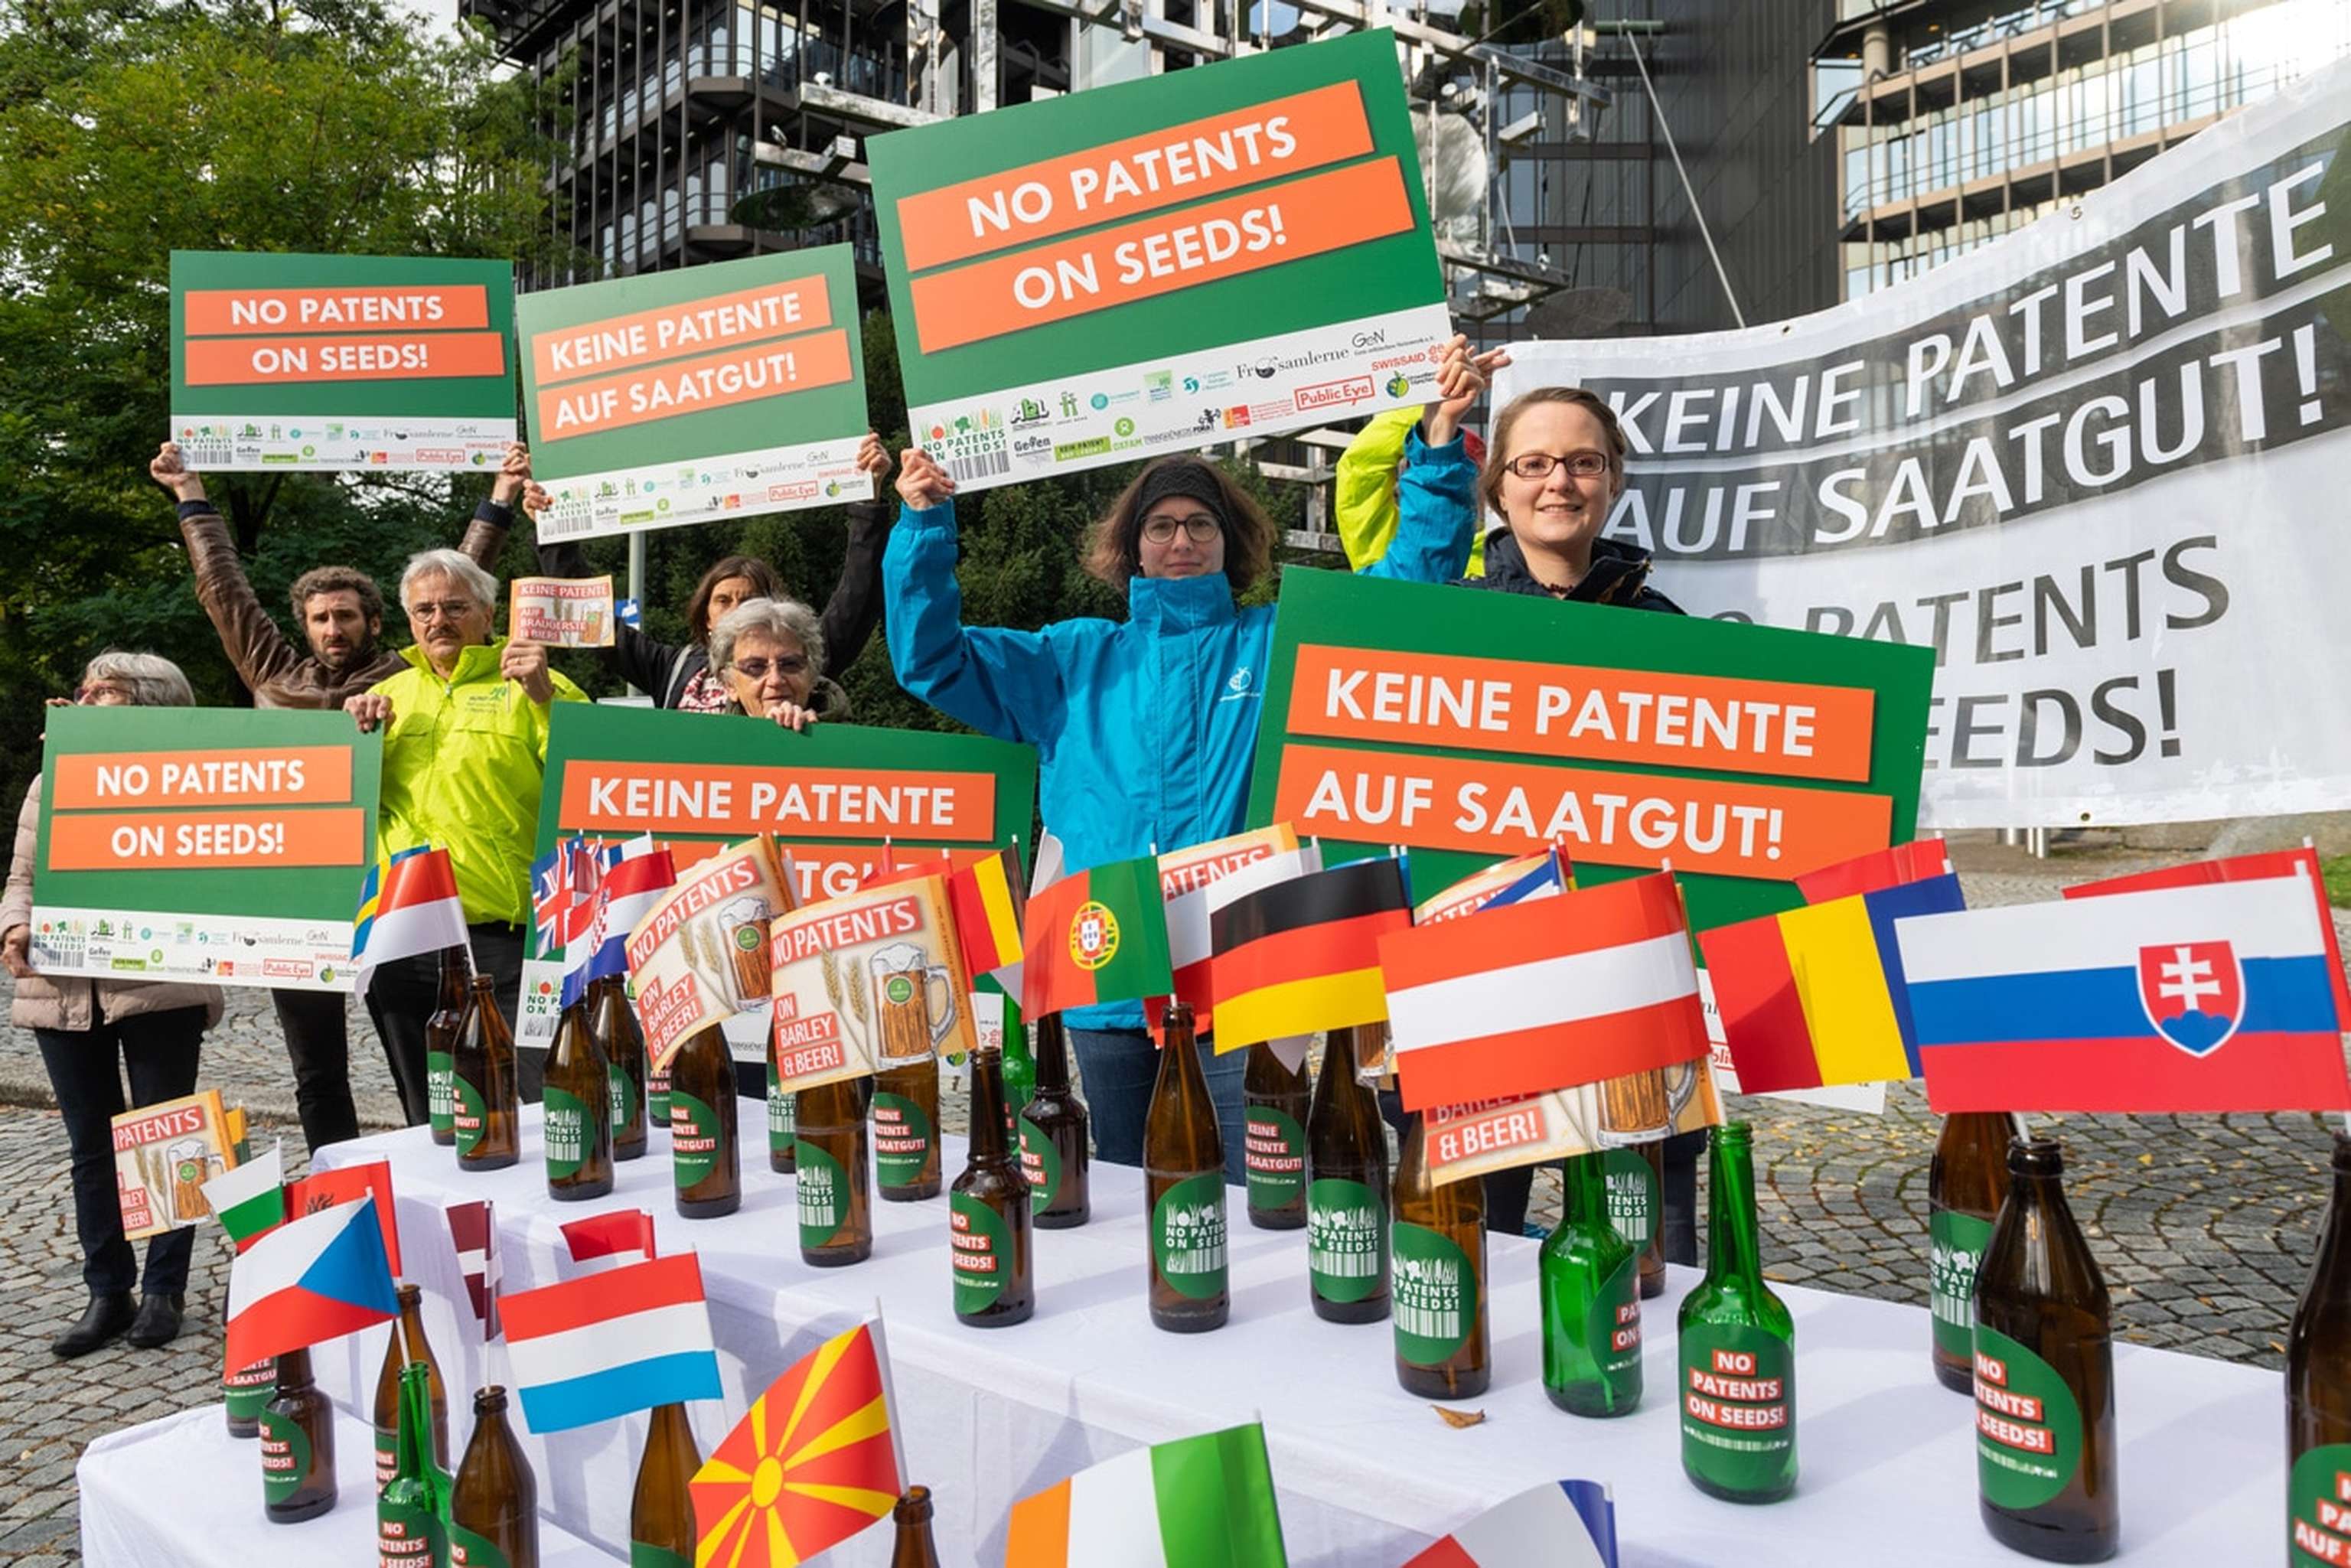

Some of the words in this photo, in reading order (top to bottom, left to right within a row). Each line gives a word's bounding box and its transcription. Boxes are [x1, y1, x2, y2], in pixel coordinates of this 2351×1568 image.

[967, 181, 1052, 238] NO
[1071, 116, 1296, 211] PATENTS
[1013, 253, 1101, 308] ON
[1114, 204, 1288, 285] SEEDS!
[231, 298, 286, 325] NO
[299, 295, 444, 324] PATENTS
[1609, 360, 1864, 455] KEINE
[1906, 160, 2333, 419] PATENTE
[550, 325, 648, 372] KEINE
[657, 292, 801, 349] PATENTE
[252, 348, 308, 374] ON
[320, 344, 428, 372] SEEDS!
[1371, 353, 1426, 372] SWISSAID
[554, 388, 618, 429] AUF
[628, 351, 797, 413] SAATGUT!
[1300, 390, 1342, 406] Public
[1344, 383, 1369, 406] Eye
[947, 429, 1006, 448] PATENTS
[954, 439, 1008, 458] SEEDS!
[1603, 480, 1781, 554] AUF
[1815, 324, 2324, 546] SAATGUT!
[1325, 668, 1512, 731] KEINE
[1536, 686, 1816, 758] PATENTE
[96, 764, 149, 797] NO
[161, 760, 305, 795] PATENTS
[589, 777, 732, 820] KEINE
[750, 781, 955, 826] PATENTE
[1303, 770, 1433, 826] AUF
[1456, 783, 1783, 860] SAATGUT!
[111, 825, 165, 858] ON
[175, 822, 284, 856] SEEDS!
[631, 934, 656, 970] NO
[655, 859, 755, 942] PATENTS
[772, 934, 792, 967] NO
[794, 900, 916, 955] PATENTS
[527, 996, 546, 1005] NO
[527, 1005, 546, 1015] ON
[642, 982, 661, 1011] ON
[647, 980, 691, 1033] BARLEY
[778, 996, 795, 1019] ON
[661, 1003, 699, 1047] BEER!
[780, 1016, 833, 1049] BARLEY
[783, 1055, 796, 1076] &
[796, 1045, 840, 1072] BEER!
[118, 1109, 201, 1149] PATENTS
[1248, 1123, 1277, 1138] KEINE
[1438, 1134, 1459, 1162] &
[1464, 1111, 1537, 1156] BEER!
[1607, 1195, 1647, 1206] TENTS
[1166, 1227, 1185, 1237] NO
[1166, 1238, 1187, 1248] ON
[1322, 1228, 1378, 1241] PATENTS
[1327, 1240, 1378, 1253] SEEDS!
[1398, 1280, 1459, 1298] PATENTS
[1403, 1293, 1459, 1310] SEEDS!
[1717, 1352, 1752, 1371] NO
[1975, 1351, 2002, 1381] NO
[233, 1371, 277, 1385] SAATGU
[1693, 1371, 1778, 1399] PATENTS
[1689, 1397, 1715, 1420] ON
[1721, 1405, 1783, 1426] SEEDS!
[1981, 1411, 2046, 1449] SEEDS!
[383, 1522, 403, 1534] NO
[2294, 1521, 2341, 1560] AUF
